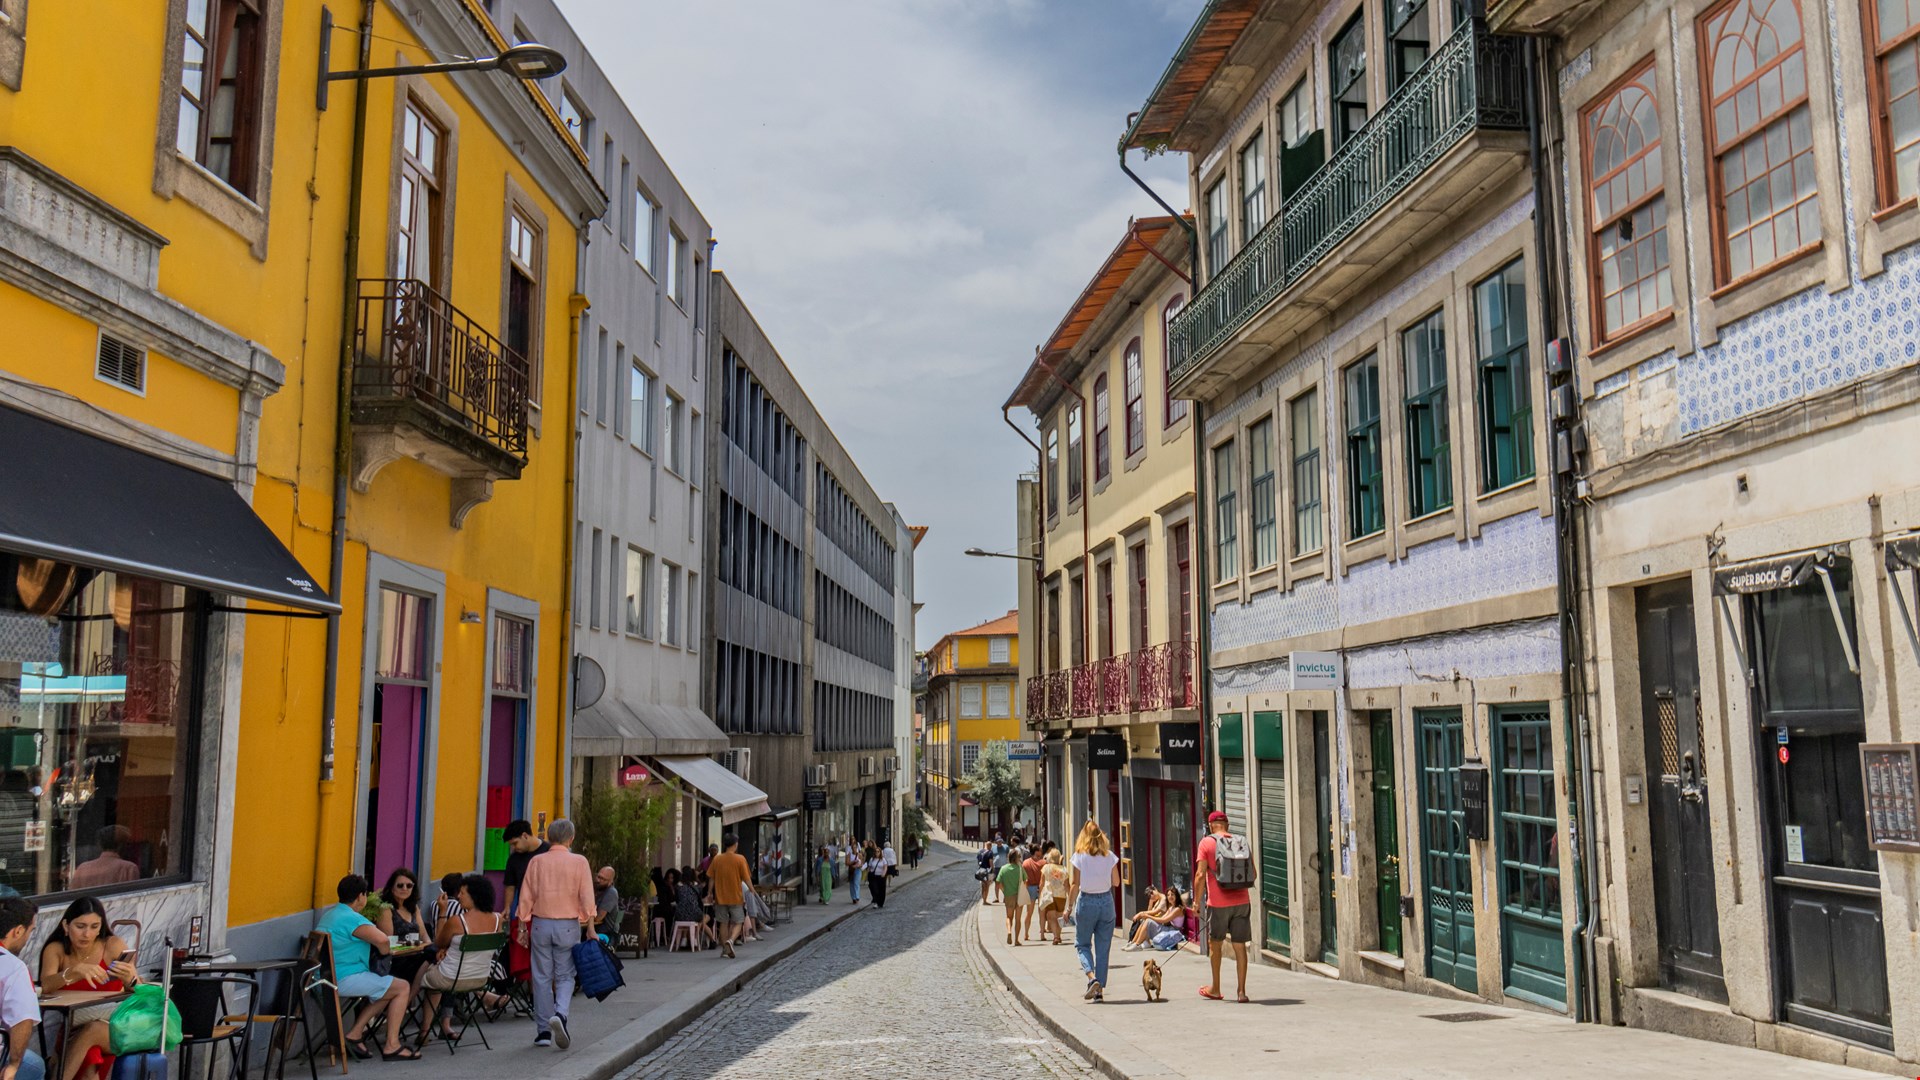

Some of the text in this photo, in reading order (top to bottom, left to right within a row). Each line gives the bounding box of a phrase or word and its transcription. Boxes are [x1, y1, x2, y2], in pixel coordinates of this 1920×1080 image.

[1730, 574, 1754, 588] SUPER
[1755, 571, 1777, 584] BOCK
[1296, 663, 1336, 672] invictus
[1168, 739, 1195, 748] EASY
[1096, 748, 1116, 756] Selina
[626, 772, 647, 782] Lazy
